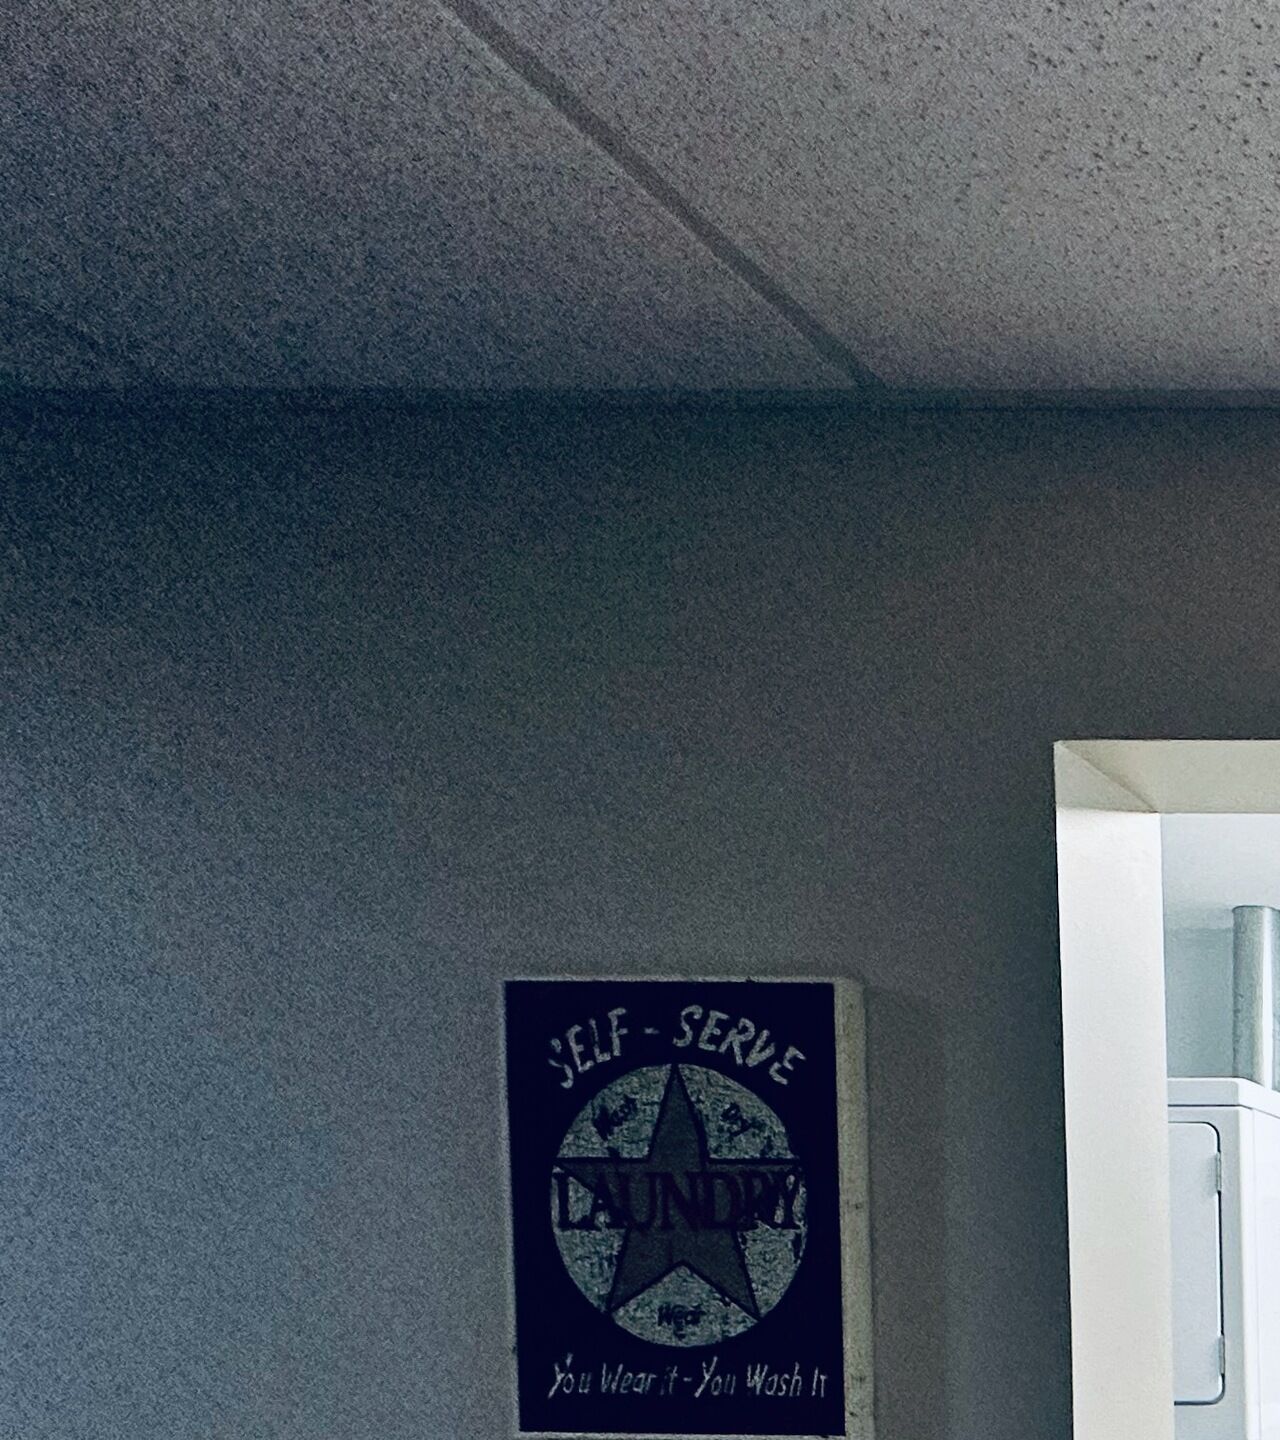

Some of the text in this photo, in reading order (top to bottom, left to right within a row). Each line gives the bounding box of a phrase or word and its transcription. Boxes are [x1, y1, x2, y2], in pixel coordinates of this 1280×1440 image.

[555, 1168, 803, 1232] LAUNDRY
[547, 1352, 592, 1399] You
[694, 1355, 737, 1399] You
[746, 1361, 802, 1398] Wash
